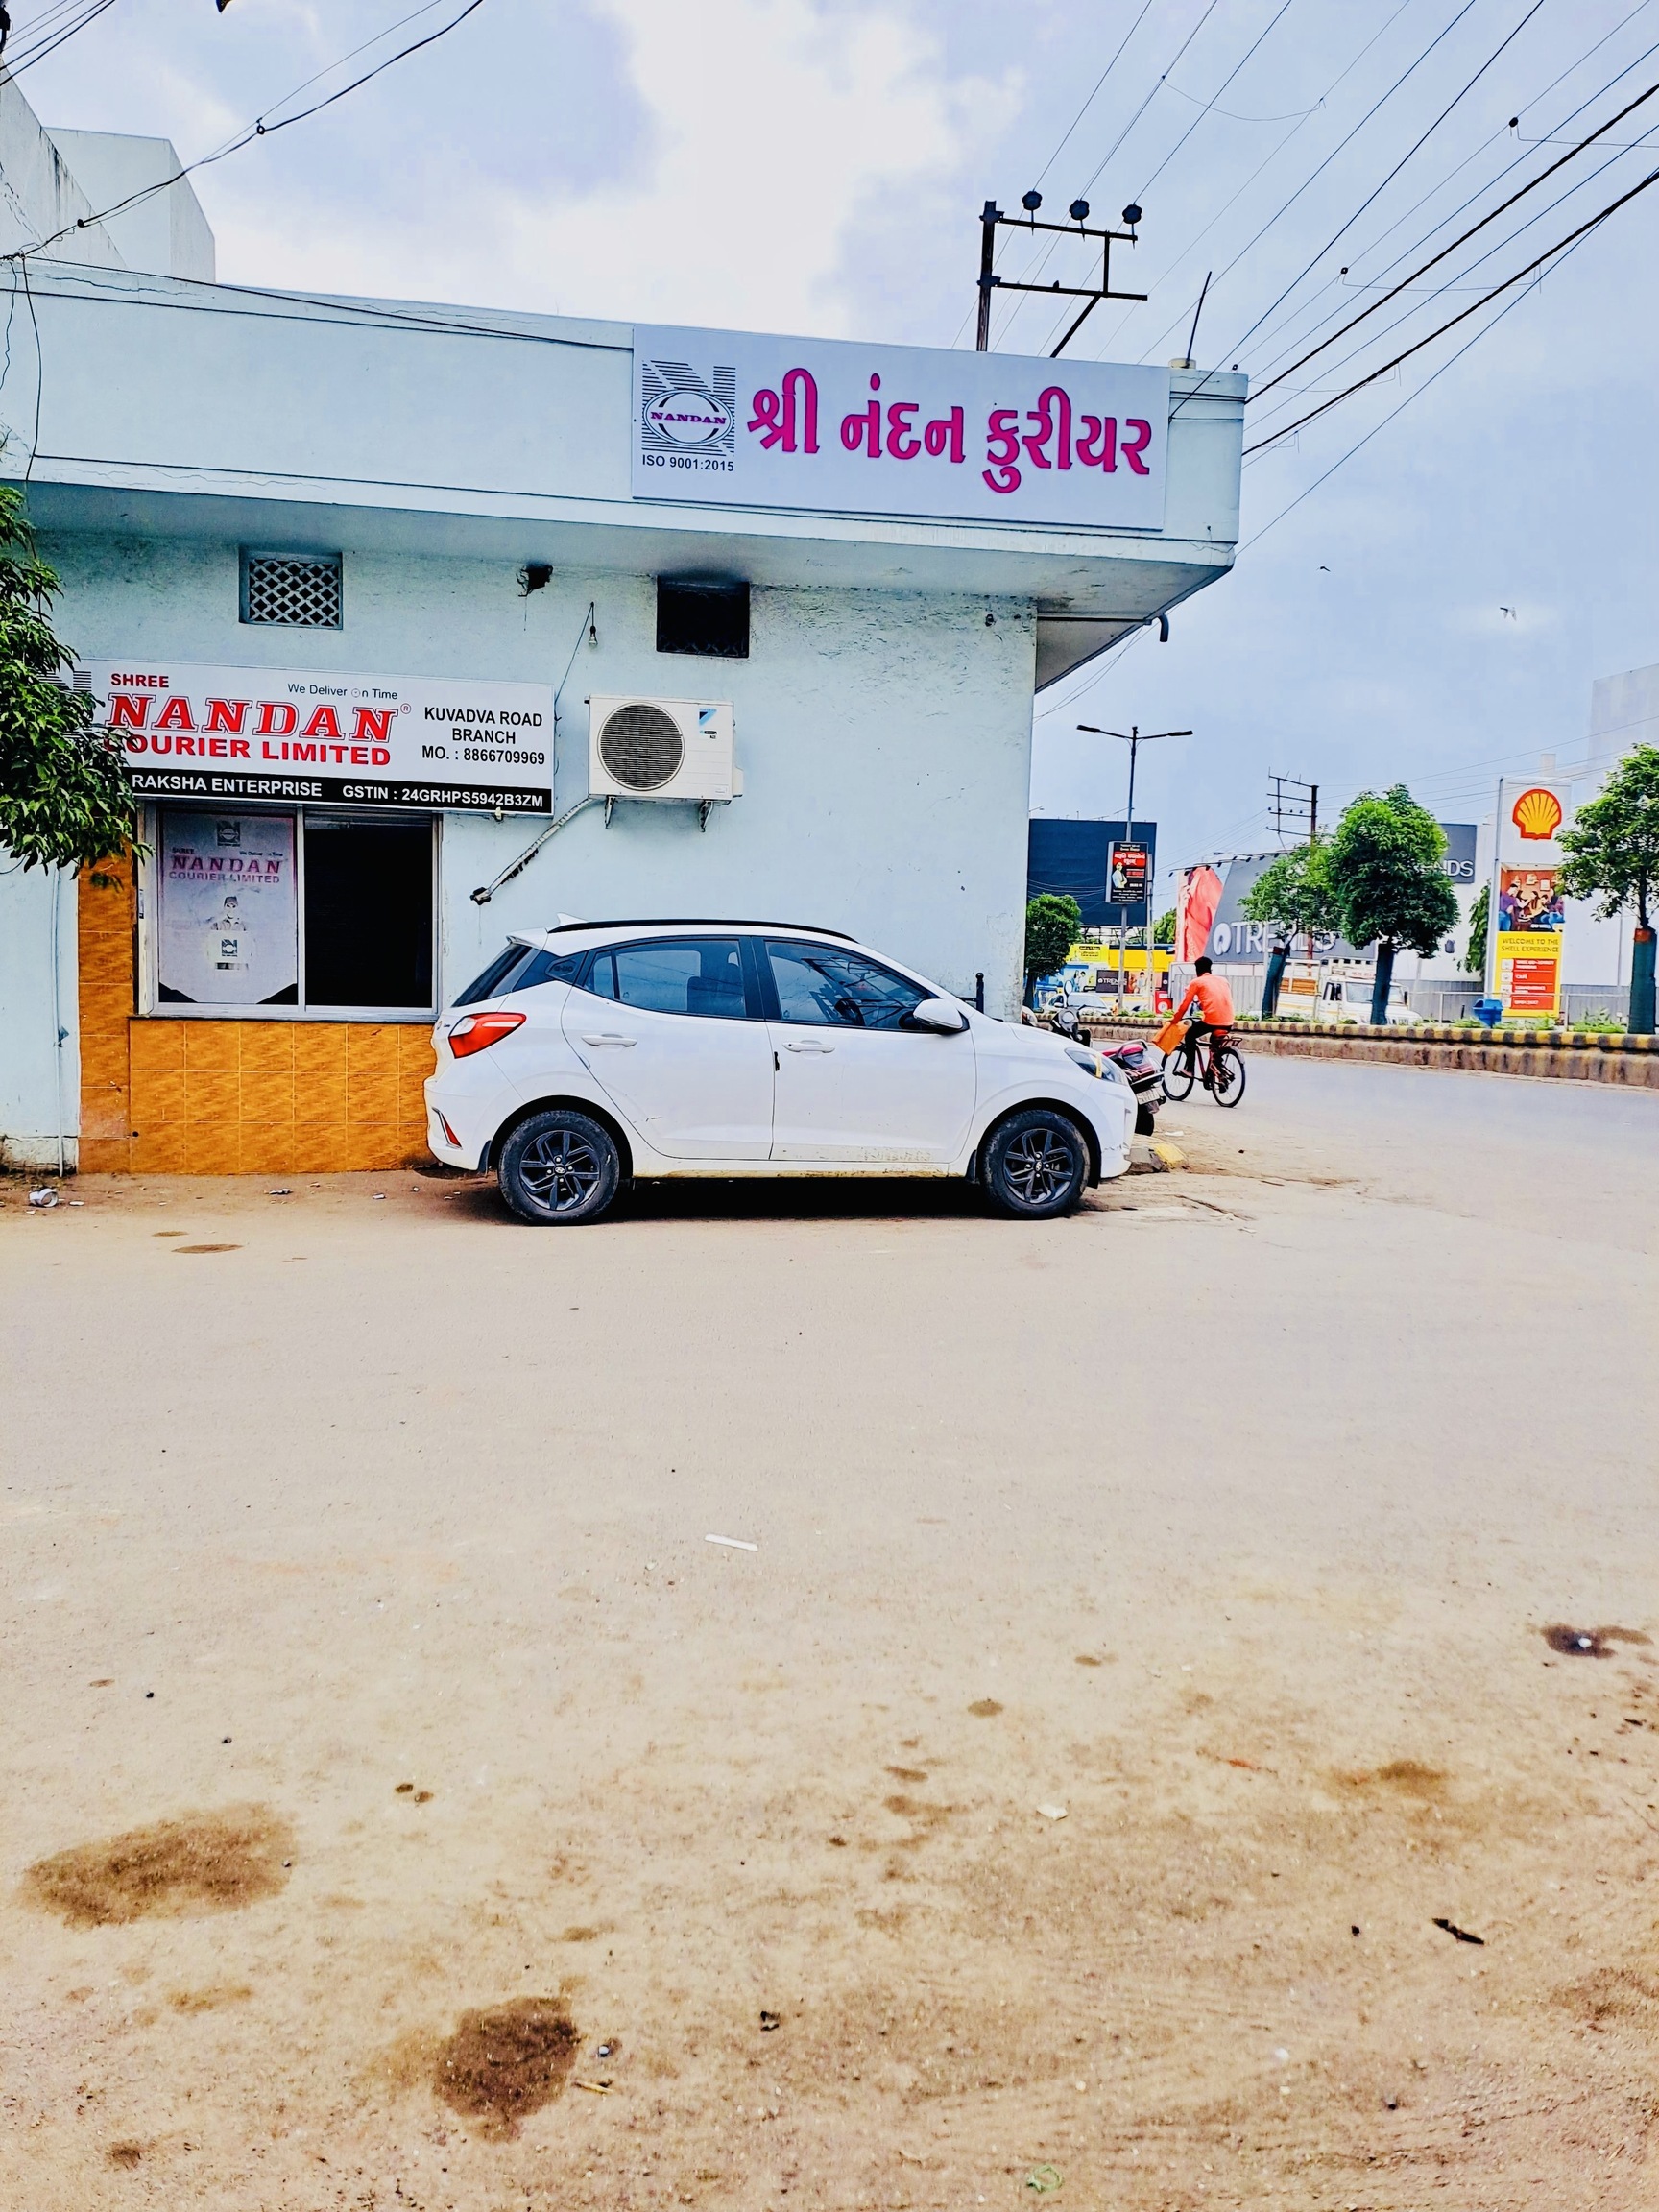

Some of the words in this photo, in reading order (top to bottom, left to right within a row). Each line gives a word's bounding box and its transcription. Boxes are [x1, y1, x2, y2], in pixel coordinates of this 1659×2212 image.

[650, 412, 727, 425] NANDAN
[747, 368, 821, 454] શ્રી
[840, 373, 966, 464] નંદન
[982, 386, 1152, 493] કુરીયર
[642, 454, 665, 467] ISO
[669, 456, 734, 472] 9001:2015
[110, 673, 169, 688] SHREE
[287, 683, 305, 694] We
[309, 685, 348, 697] Deliver
[372, 687, 398, 700] Time
[424, 707, 496, 725] KUVADVA
[499, 710, 543, 727] ROAD
[452, 728, 517, 744] BRANCH
[262, 741, 391, 766] LIMITED
[463, 747, 545, 765] 8866709969
[132, 774, 208, 791] RAKSHA
[211, 777, 323, 798] ENTERPRISE
[342, 784, 389, 800] GSTIN
[401, 788, 543, 807] 24GRHPS5942B3ZM
[171, 854, 283, 874] NANDAN
[169, 871, 227, 882] COURIER
[229, 873, 281, 884] LIMITED
